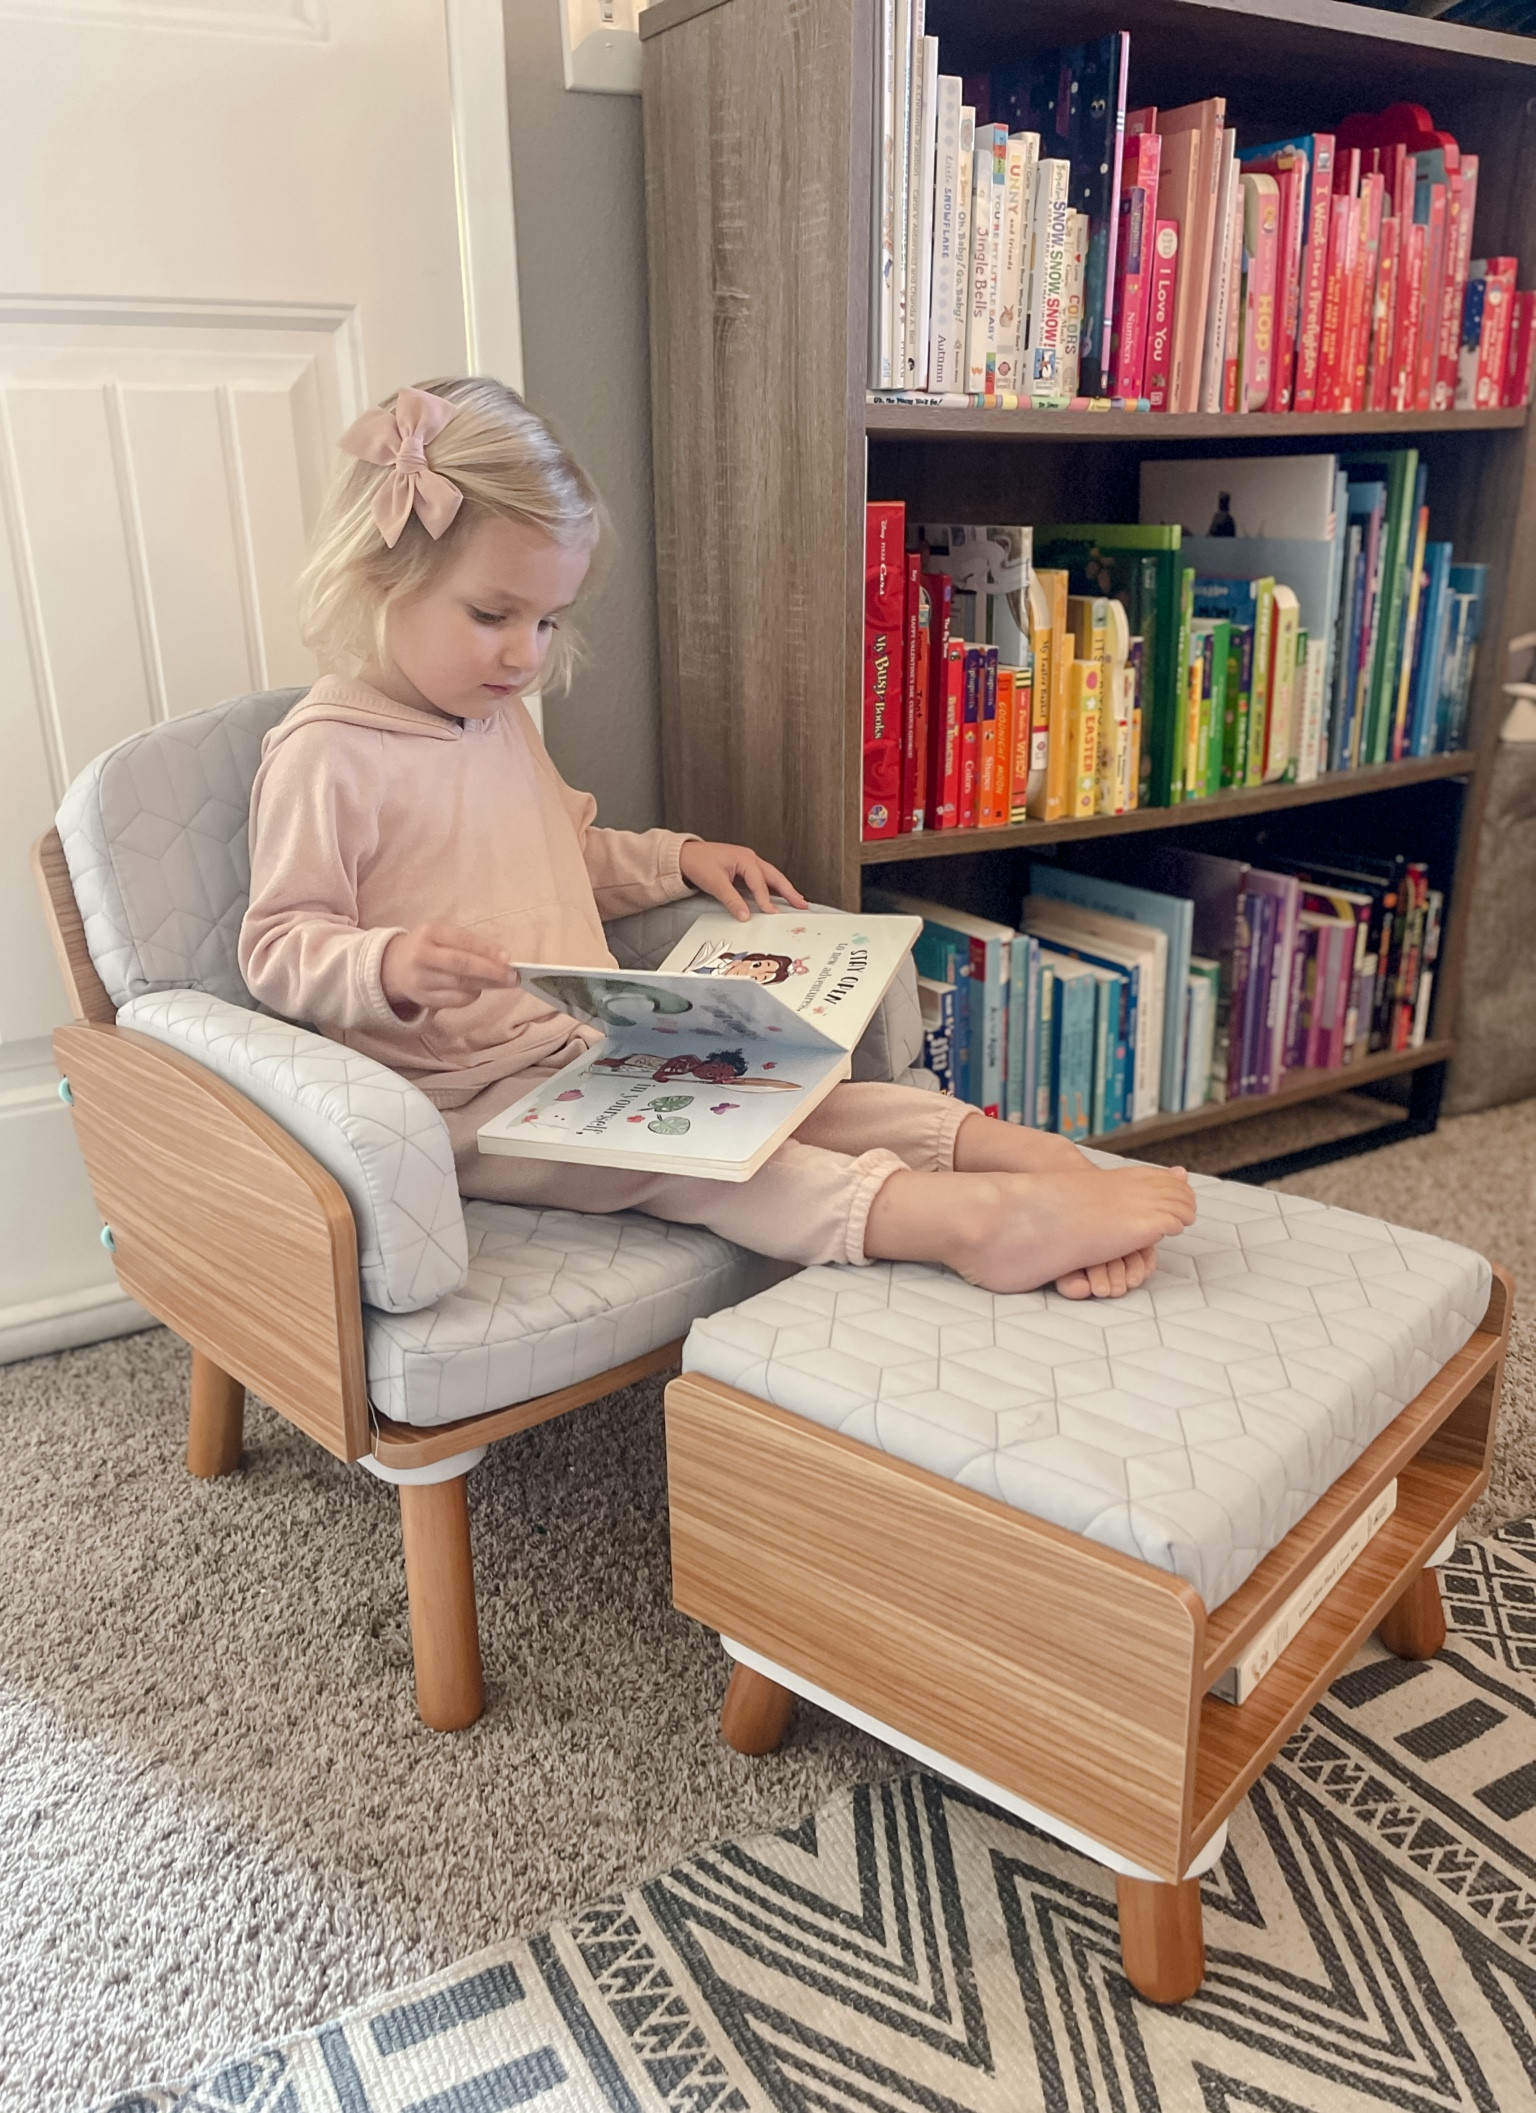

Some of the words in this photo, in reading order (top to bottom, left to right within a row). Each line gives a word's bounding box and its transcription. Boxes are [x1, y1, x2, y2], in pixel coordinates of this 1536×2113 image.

[913, 139, 921, 177] Tradition
[1008, 155, 1021, 215] BUNNY
[1316, 186, 1327, 195] I
[942, 187, 952, 260] SNOWFLAKE
[992, 193, 1001, 238] YOU'RE
[1312, 201, 1327, 246] Want
[955, 232, 967, 269] Baby!
[974, 227, 988, 275] Jingle
[991, 242, 1001, 260] MY
[973, 280, 987, 318] Bells
[990, 265, 998, 305] LITTLE
[1155, 280, 1171, 323] Love
[953, 286, 964, 324] Baby!
[1043, 298, 1060, 348] SNOW!
[1255, 295, 1272, 352] HOP
[987, 309, 995, 342] BABY
[1065, 295, 1080, 355] COLORS
[1123, 312, 1137, 364] Numbers
[1302, 290, 1321, 379] Firefighter
[936, 334, 947, 383] Autumn
[1153, 327, 1168, 362] You
[879, 563, 887, 597] Cars
[873, 634, 886, 654] My
[908, 615, 916, 638] HAPPY
[908, 639, 916, 685] VALENTINE'S
[1040, 640, 1050, 655] My
[873, 655, 890, 701] Busy
[873, 702, 885, 740] Books
[996, 701, 1008, 763] GOODNIGHT
[1083, 716, 1096, 773] EASTER
[963, 759, 975, 794] Colors
[982, 755, 994, 792] Shapes
[995, 766, 1005, 795] MOON
[827, 952, 842, 965] new
[847, 949, 868, 973] STAY
[823, 976, 859, 1005] OPEN
[630, 1083, 656, 1093] in
